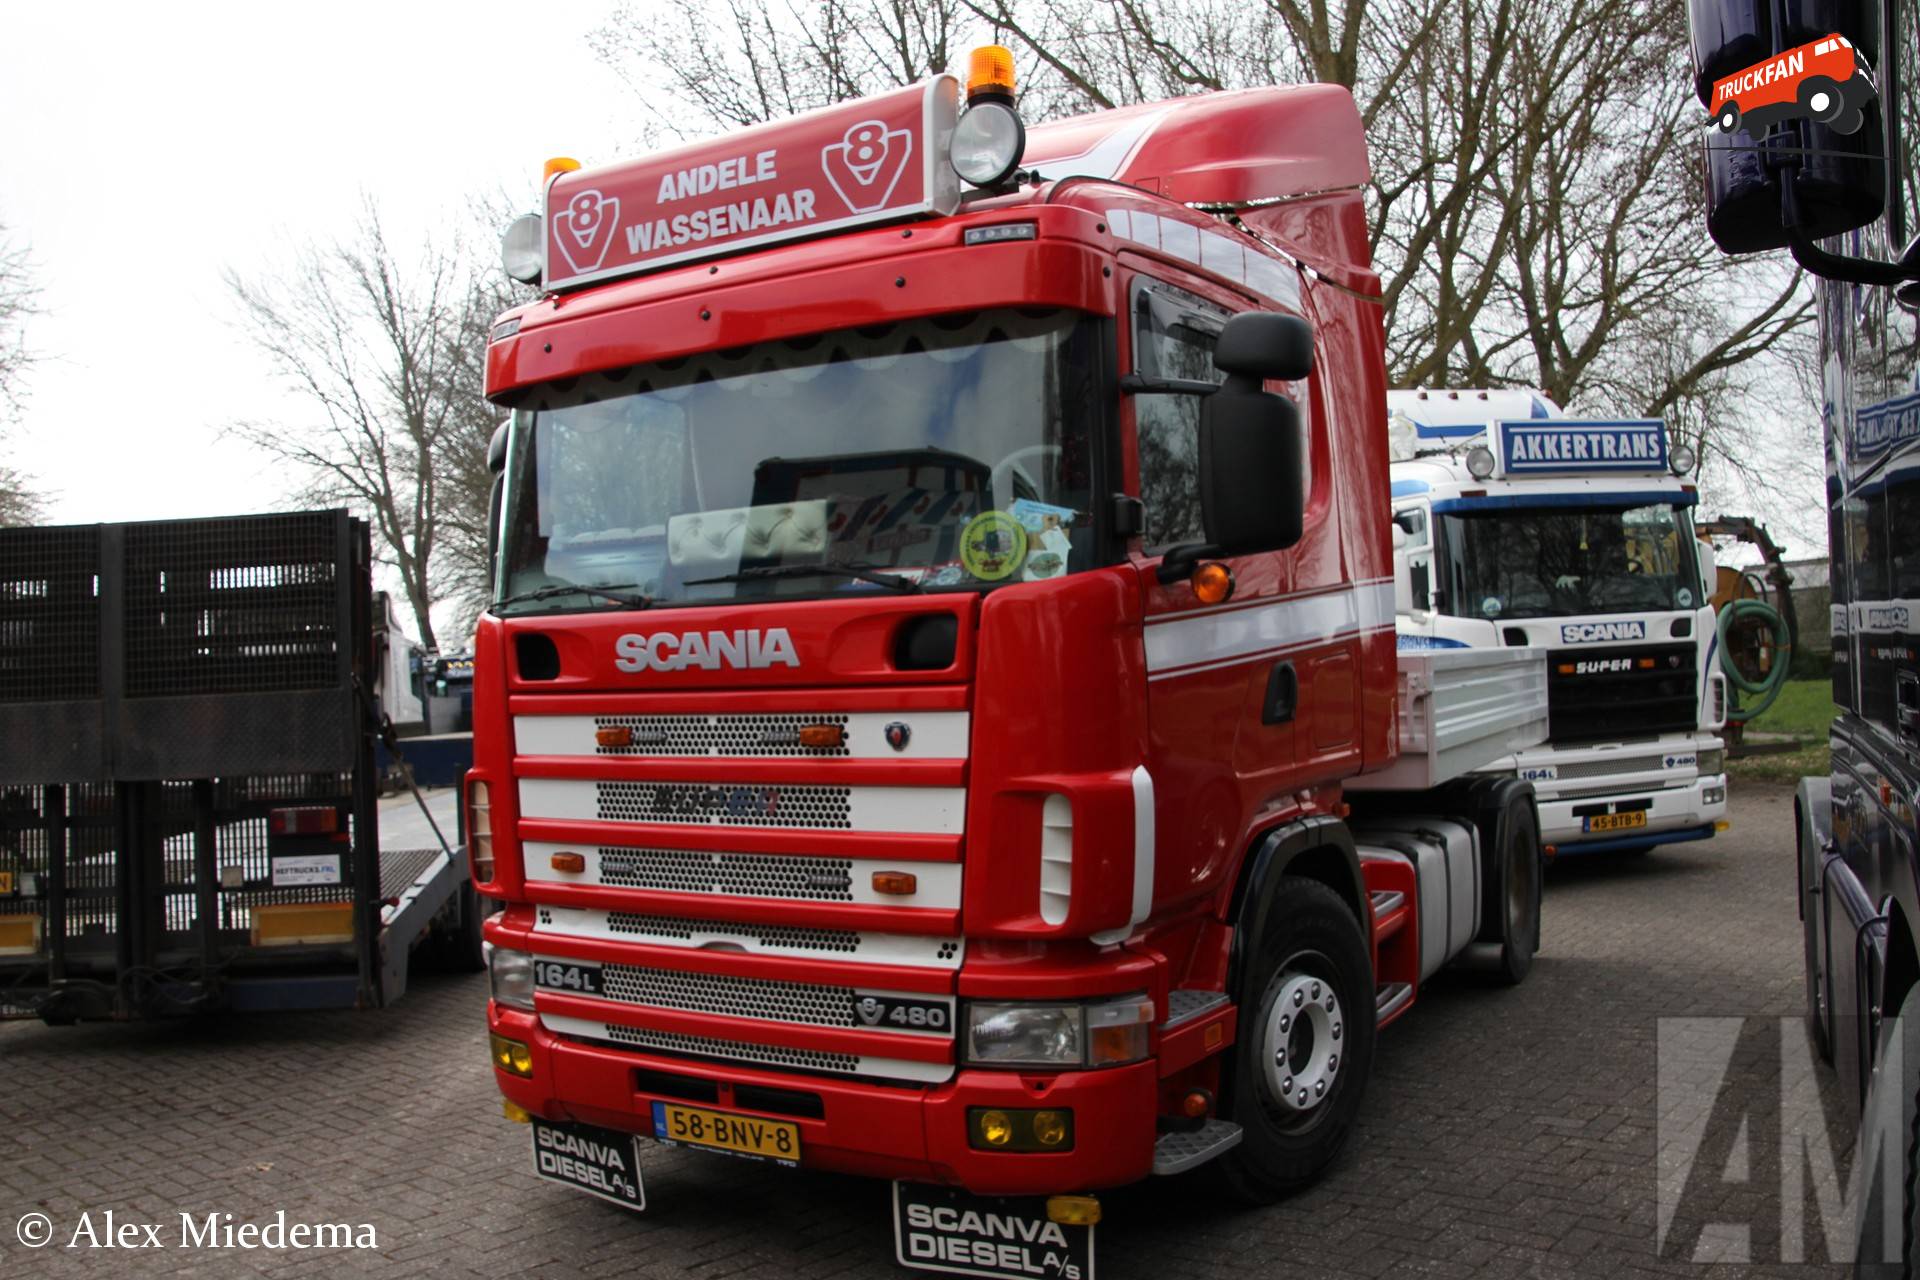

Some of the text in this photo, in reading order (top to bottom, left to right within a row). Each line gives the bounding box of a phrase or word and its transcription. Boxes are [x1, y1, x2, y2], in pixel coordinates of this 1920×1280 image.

[656, 150, 777, 204] ANDELE
[625, 188, 816, 254] WASSENAAR
[1512, 433, 1660, 460] AKKERTRANS
[1563, 622, 1643, 642] SCANIA
[614, 628, 800, 672] SCANIA
[1576, 659, 1632, 674] SUPER
[1522, 769, 1554, 781] 164L
[1676, 757, 1695, 765] 480
[1592, 813, 1642, 829] 45-BTB-9
[535, 963, 595, 991] 164L
[889, 1006, 945, 1029] 480
[537, 1126, 625, 1171] SCANVA
[673, 1111, 792, 1153] 58-BNV-8
[540, 1150, 615, 1193] DIESEL
[907, 1203, 1068, 1248] SCANVA
[909, 1232, 1080, 1279] DIESEL A/S
